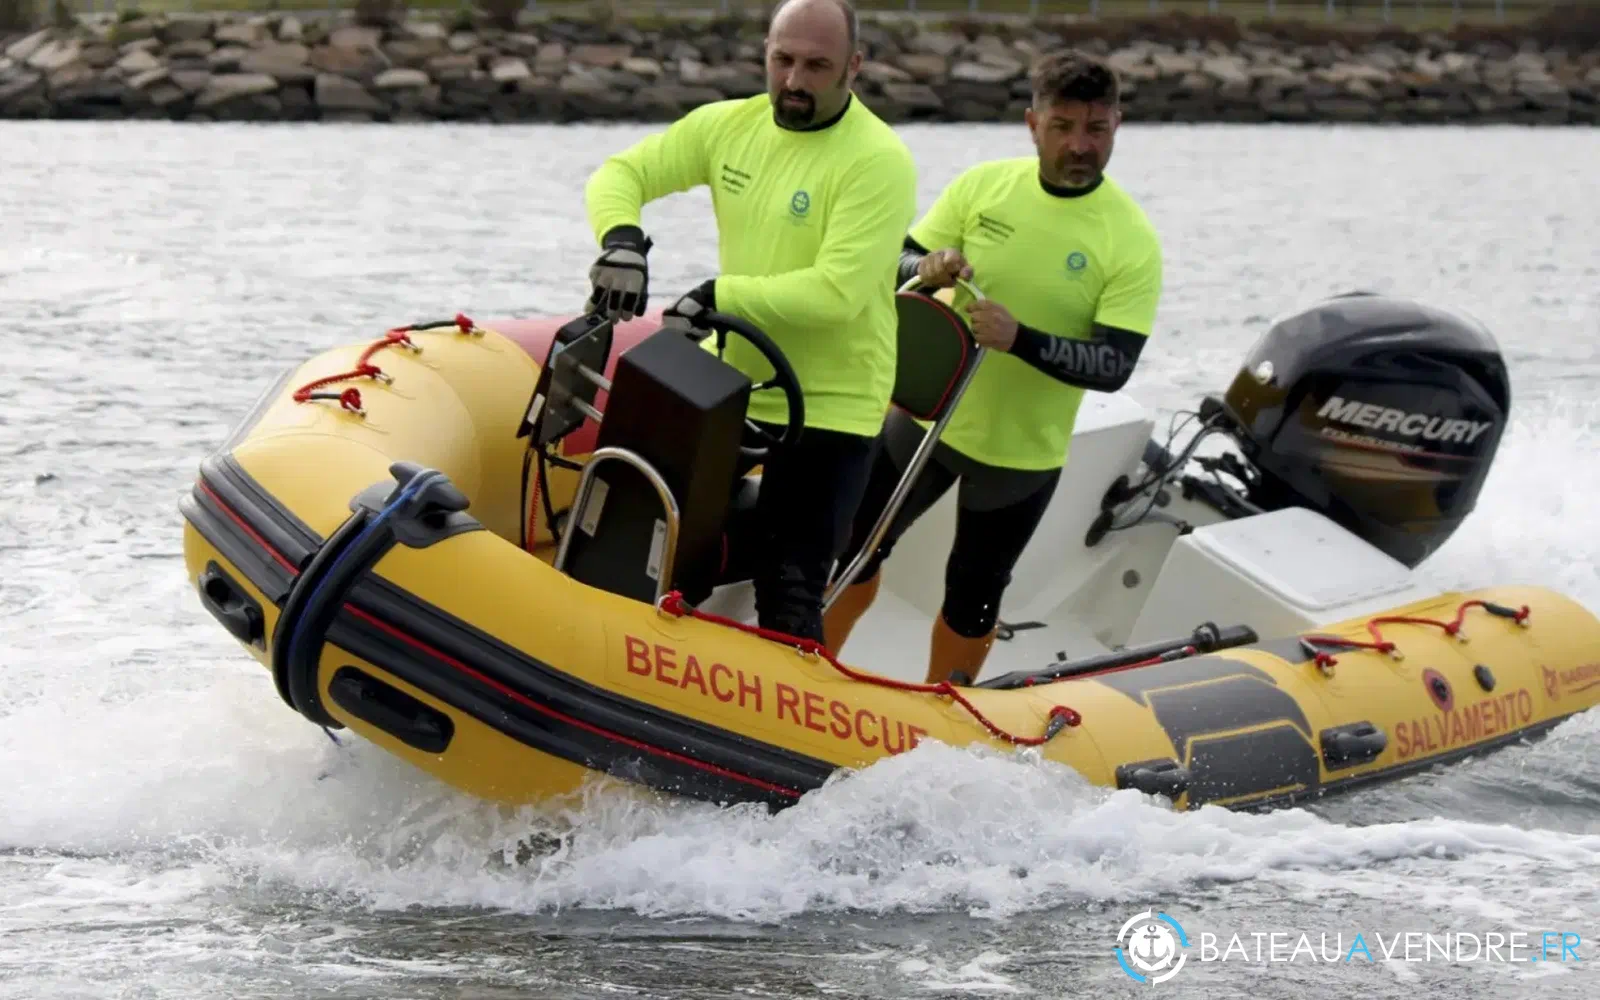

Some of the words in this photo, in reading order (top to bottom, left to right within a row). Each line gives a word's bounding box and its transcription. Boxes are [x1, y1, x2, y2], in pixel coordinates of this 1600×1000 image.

[1316, 396, 1492, 444] MERCURY
[624, 635, 763, 713] BEACH
[1395, 688, 1533, 758] SALVAMENTO
